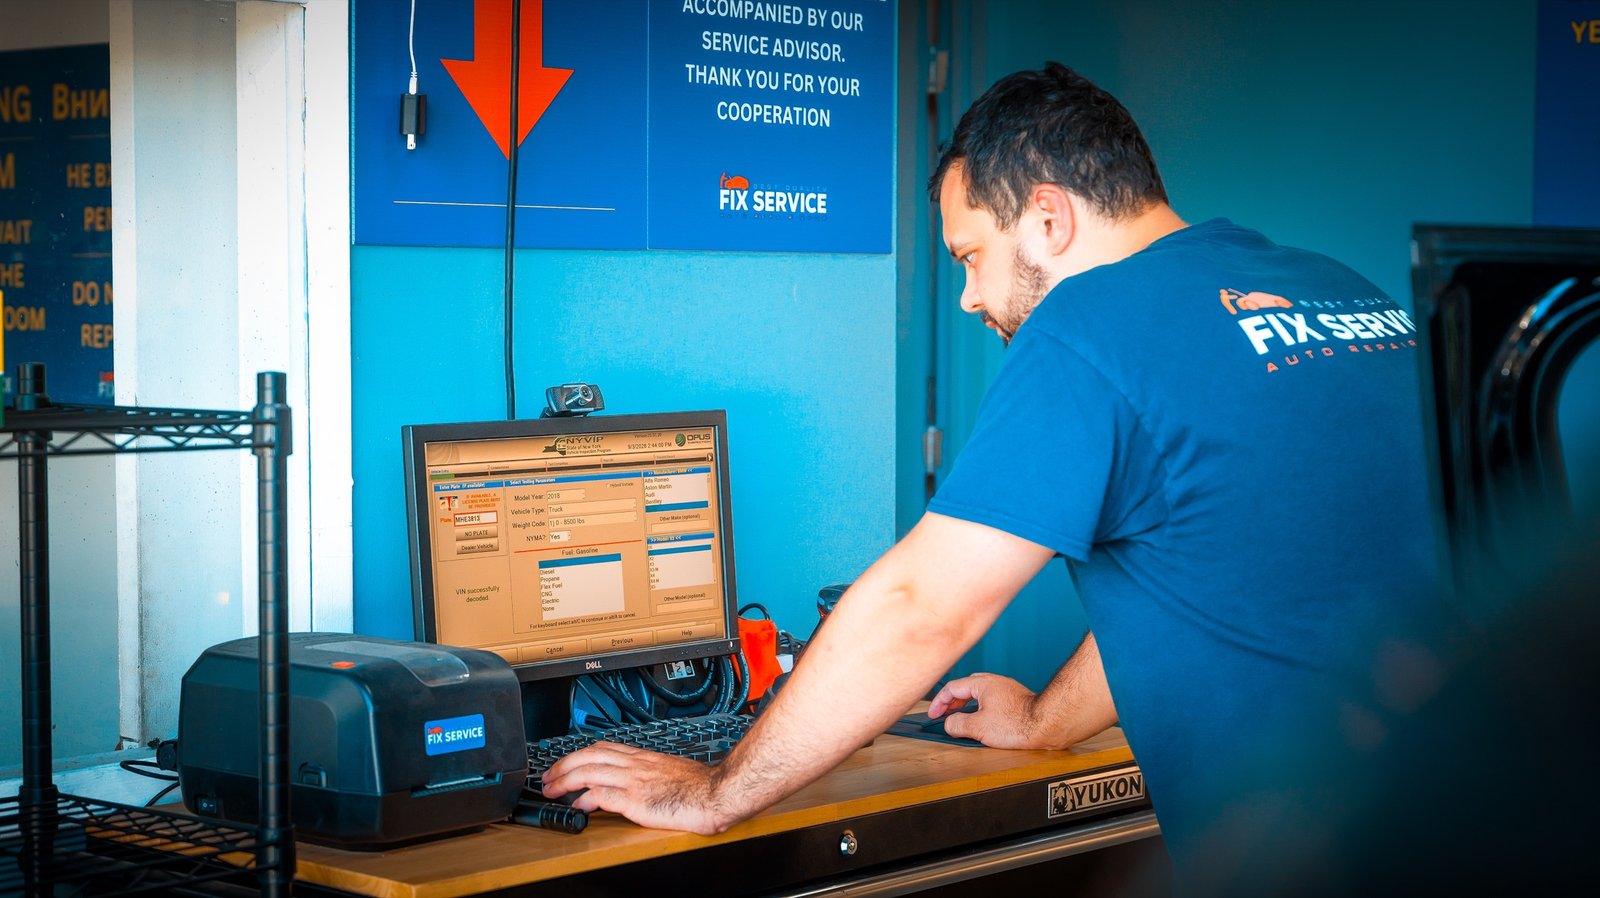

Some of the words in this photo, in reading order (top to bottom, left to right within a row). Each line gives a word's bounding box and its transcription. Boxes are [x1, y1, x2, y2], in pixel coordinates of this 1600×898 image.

[682, 0, 803, 24] ACCOMPANIED
[808, 8, 827, 27] BY
[831, 11, 863, 31] OUR
[1570, 20, 1600, 44] YE
[702, 31, 768, 56] SERVICE
[773, 38, 845, 62] ADVISOR.
[685, 64, 742, 87] THANK
[746, 70, 778, 90] YOU
[784, 73, 814, 93] FOR
[818, 76, 860, 96] YOUR
[717, 101, 830, 127] COOPERATION
[720, 189, 748, 210] FIX
[753, 190, 827, 213] SERVICE
[0, 220, 32, 244] AIT
[72, 281, 100, 305] DO
[1238, 313, 1326, 355] FIX
[1267, 347, 1334, 373] AUTO
[1348, 340, 1416, 353] REPAIR
[586, 661, 602, 669] DELL
[428, 733, 443, 744] FIX
[445, 727, 483, 742] SERVICE
[1074, 775, 1141, 806] YUKON
